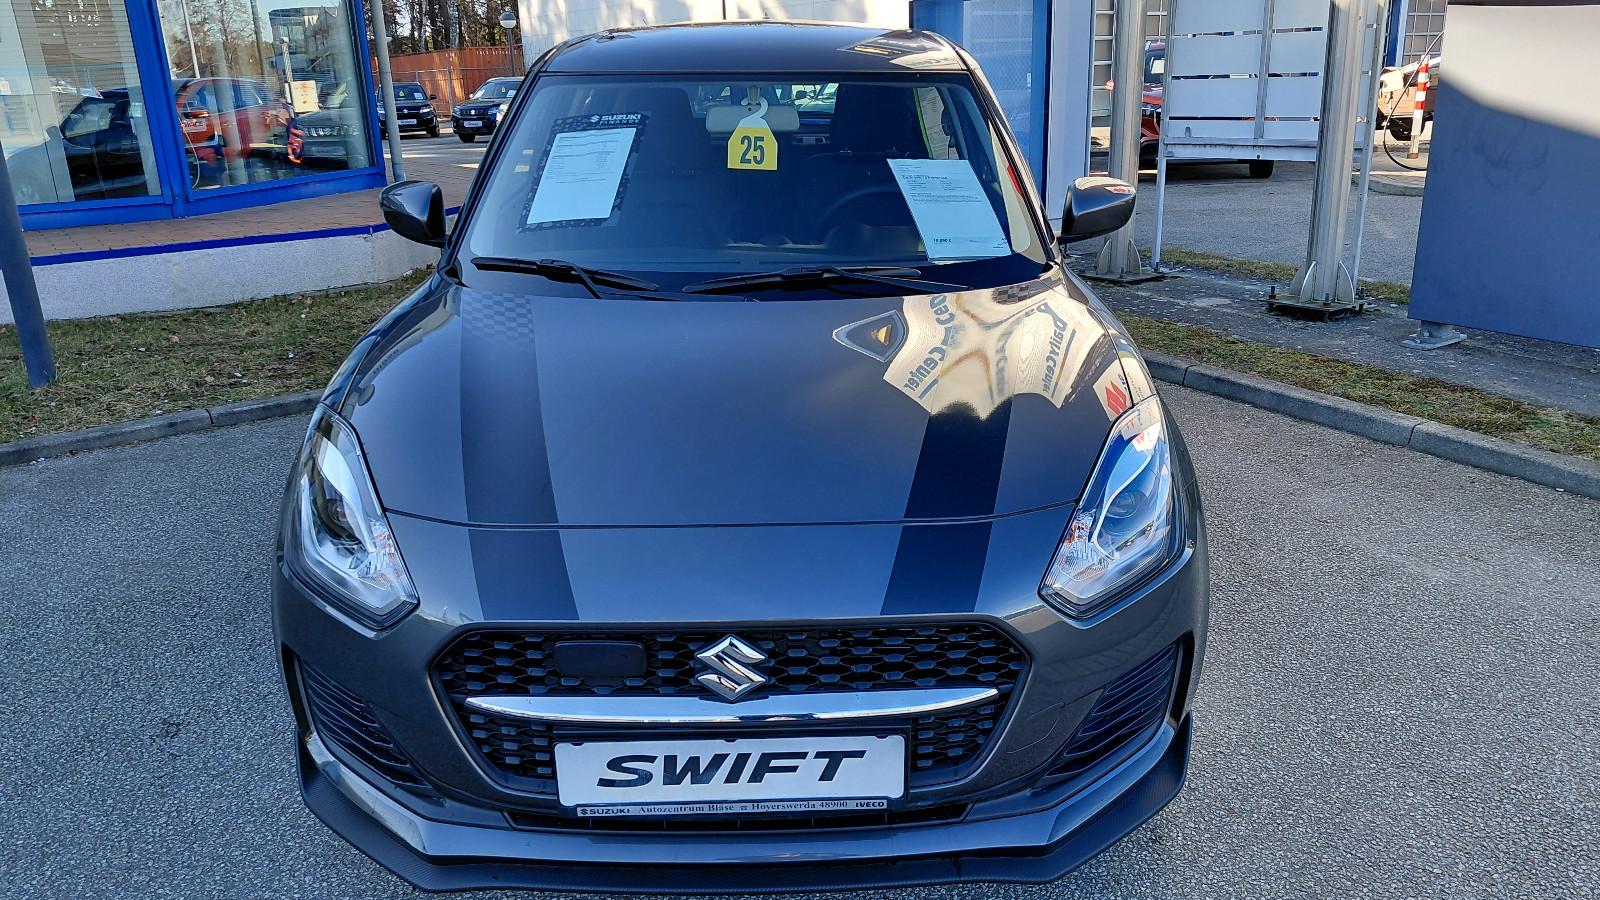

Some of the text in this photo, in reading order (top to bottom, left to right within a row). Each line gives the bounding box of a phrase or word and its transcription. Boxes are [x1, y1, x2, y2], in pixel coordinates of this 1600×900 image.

[740, 135, 765, 165] 25
[596, 750, 867, 788] SWIFT
[638, 804, 705, 813] Autozentrum
[751, 801, 816, 811] Hoyerswerda
